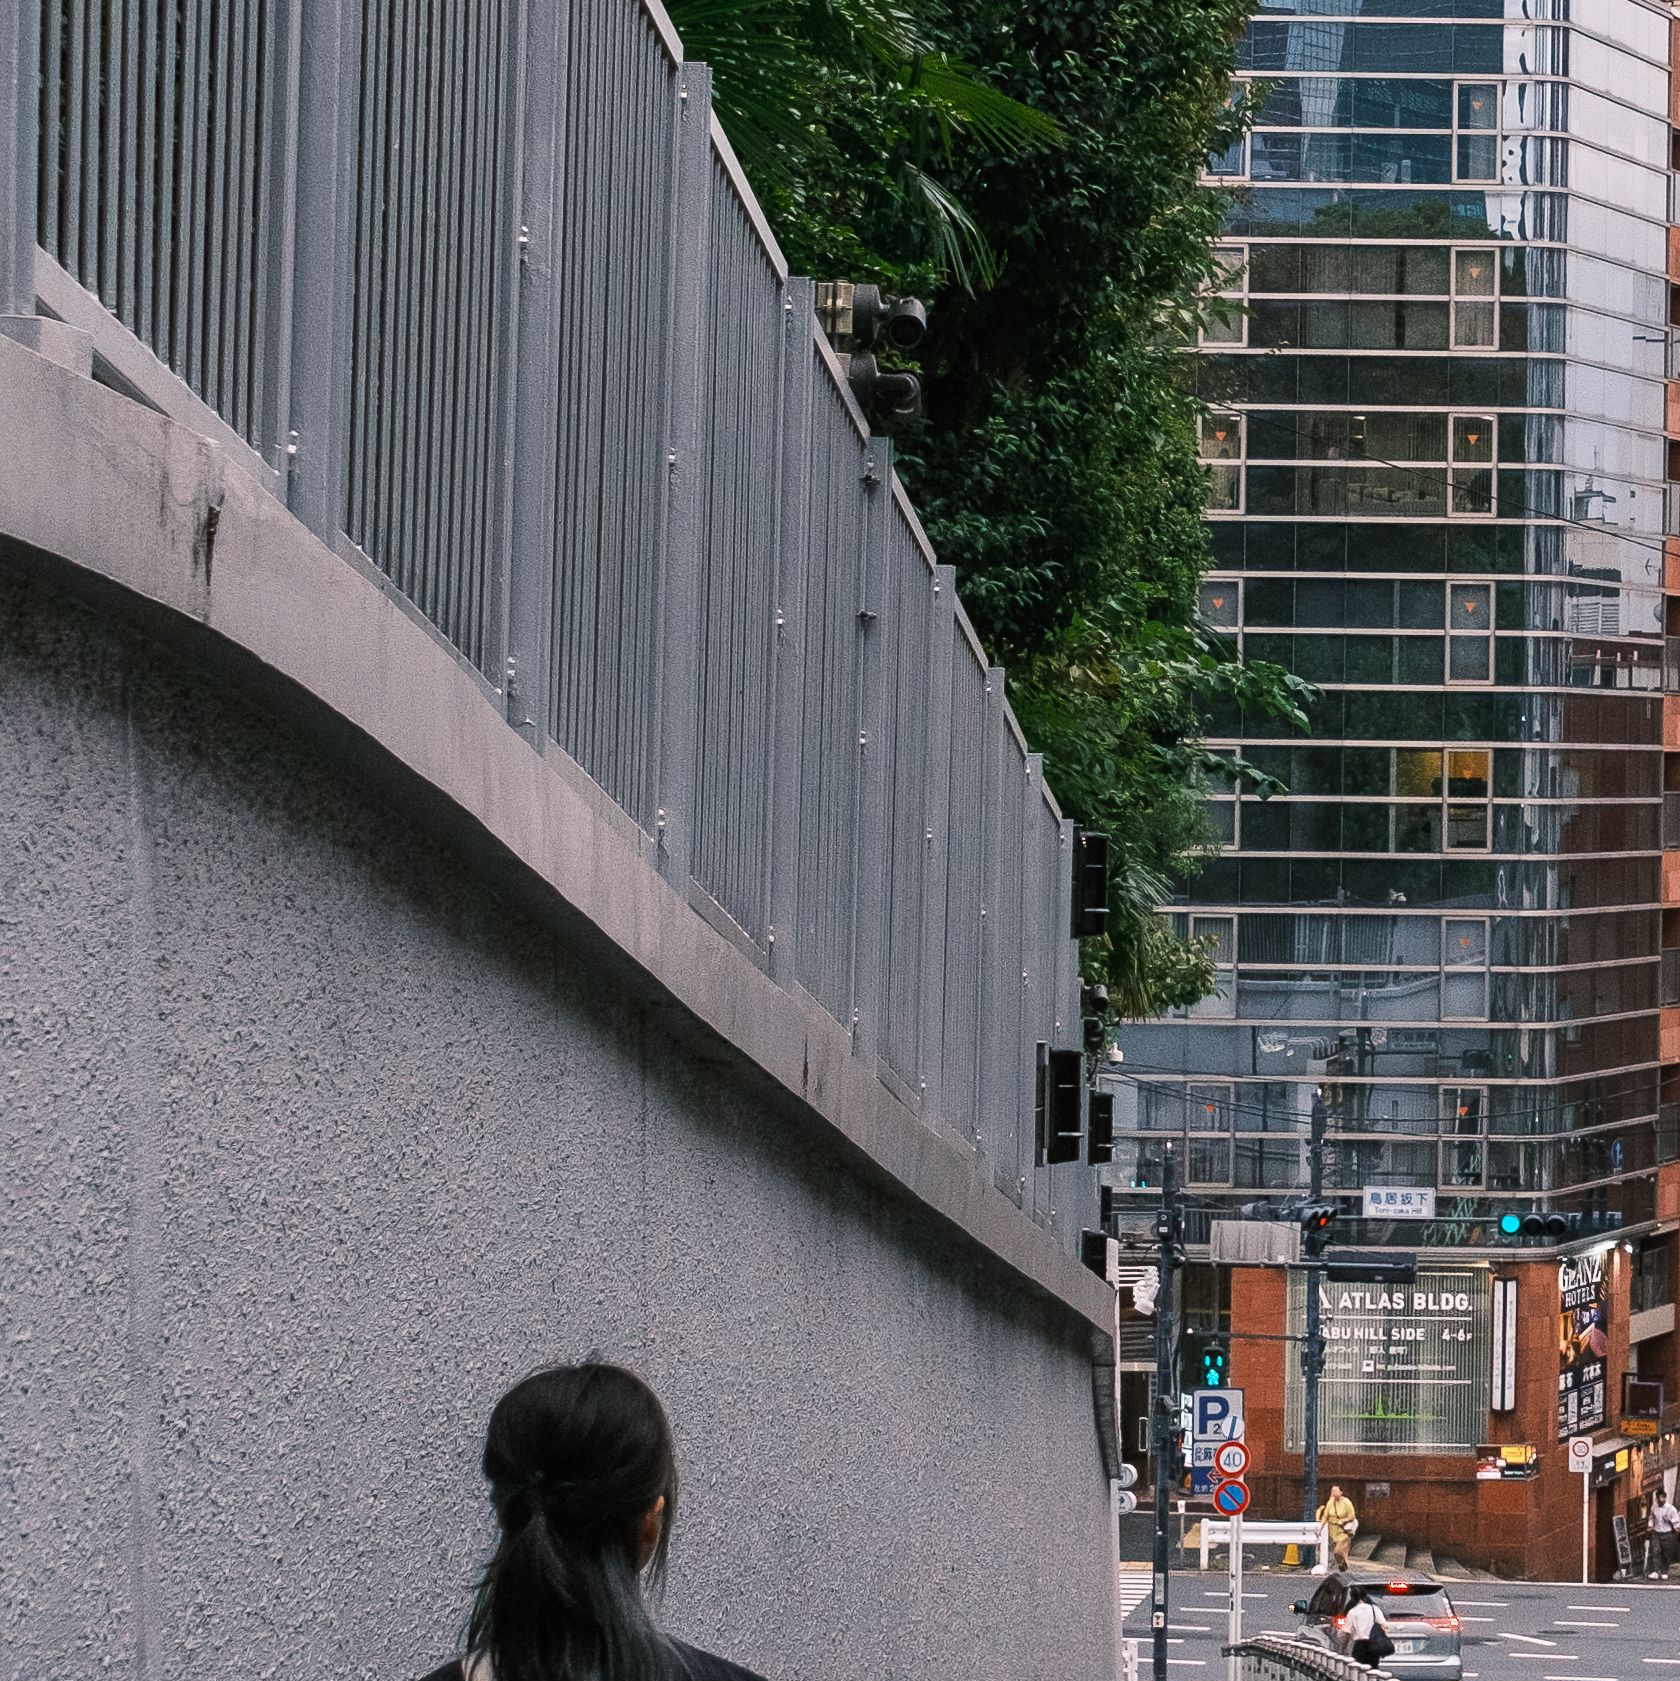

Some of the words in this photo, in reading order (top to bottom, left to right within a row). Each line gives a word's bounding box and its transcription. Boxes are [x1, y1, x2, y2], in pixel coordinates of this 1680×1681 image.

[1370, 1191, 1429, 1206] 鳥居坂下
[1338, 1291, 1405, 1310] ATLAS
[1413, 1292, 1474, 1311] BLDG.
[1565, 1284, 1596, 1308] HOTELS
[1354, 1326, 1388, 1341] HILL
[1391, 1327, 1426, 1341] SIDE
[1199, 1396, 1229, 1434] P
[1223, 1452, 1242, 1467] 40
